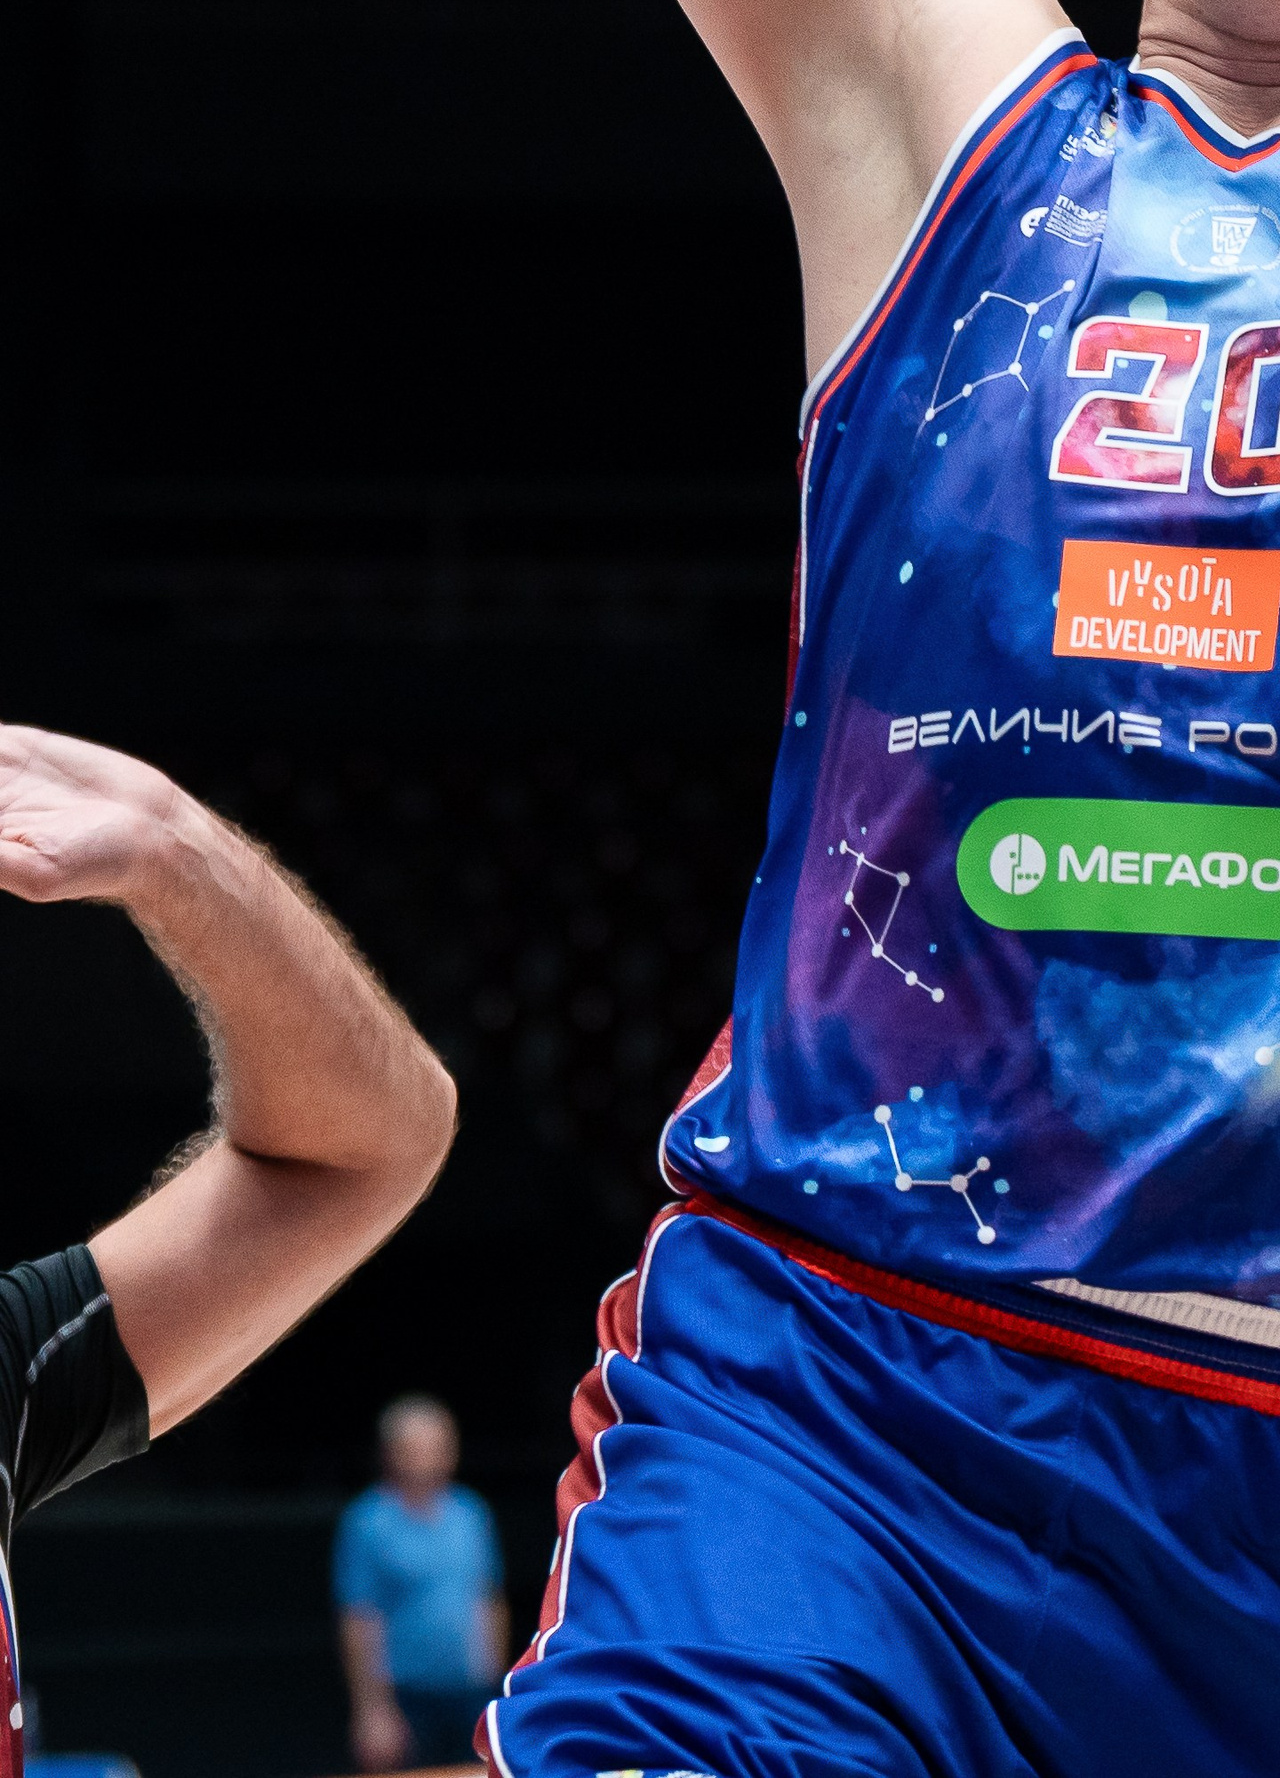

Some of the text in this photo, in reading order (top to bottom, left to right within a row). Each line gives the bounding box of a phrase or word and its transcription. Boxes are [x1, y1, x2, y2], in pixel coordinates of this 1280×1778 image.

[1107, 557, 1234, 617] VYSOTA
[1069, 616, 1262, 664] DEVELOPMENT
[888, 707, 1162, 754] ВЕЛИЧИЕ
